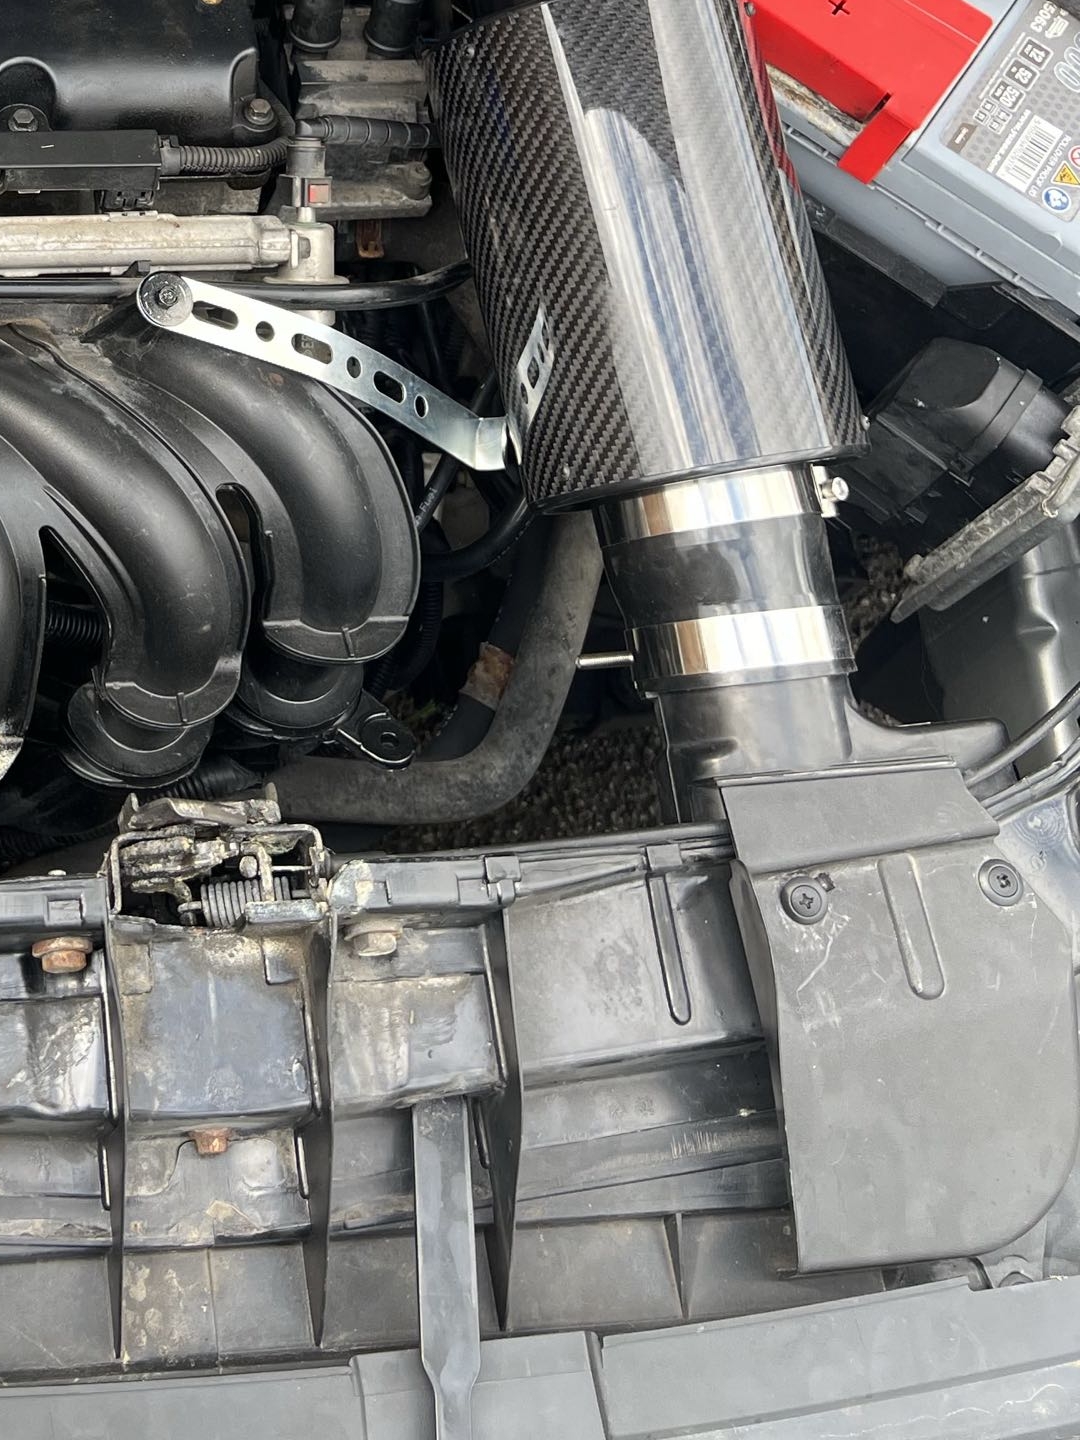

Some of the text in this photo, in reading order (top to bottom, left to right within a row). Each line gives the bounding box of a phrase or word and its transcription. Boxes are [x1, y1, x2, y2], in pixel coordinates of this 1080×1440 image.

[1028, 47, 1046, 63] 12
[1014, 67, 1033, 84] 52
[999, 85, 1020, 108] 520
[1027, 134, 1072, 198] ROLLOVER PROOF LID
